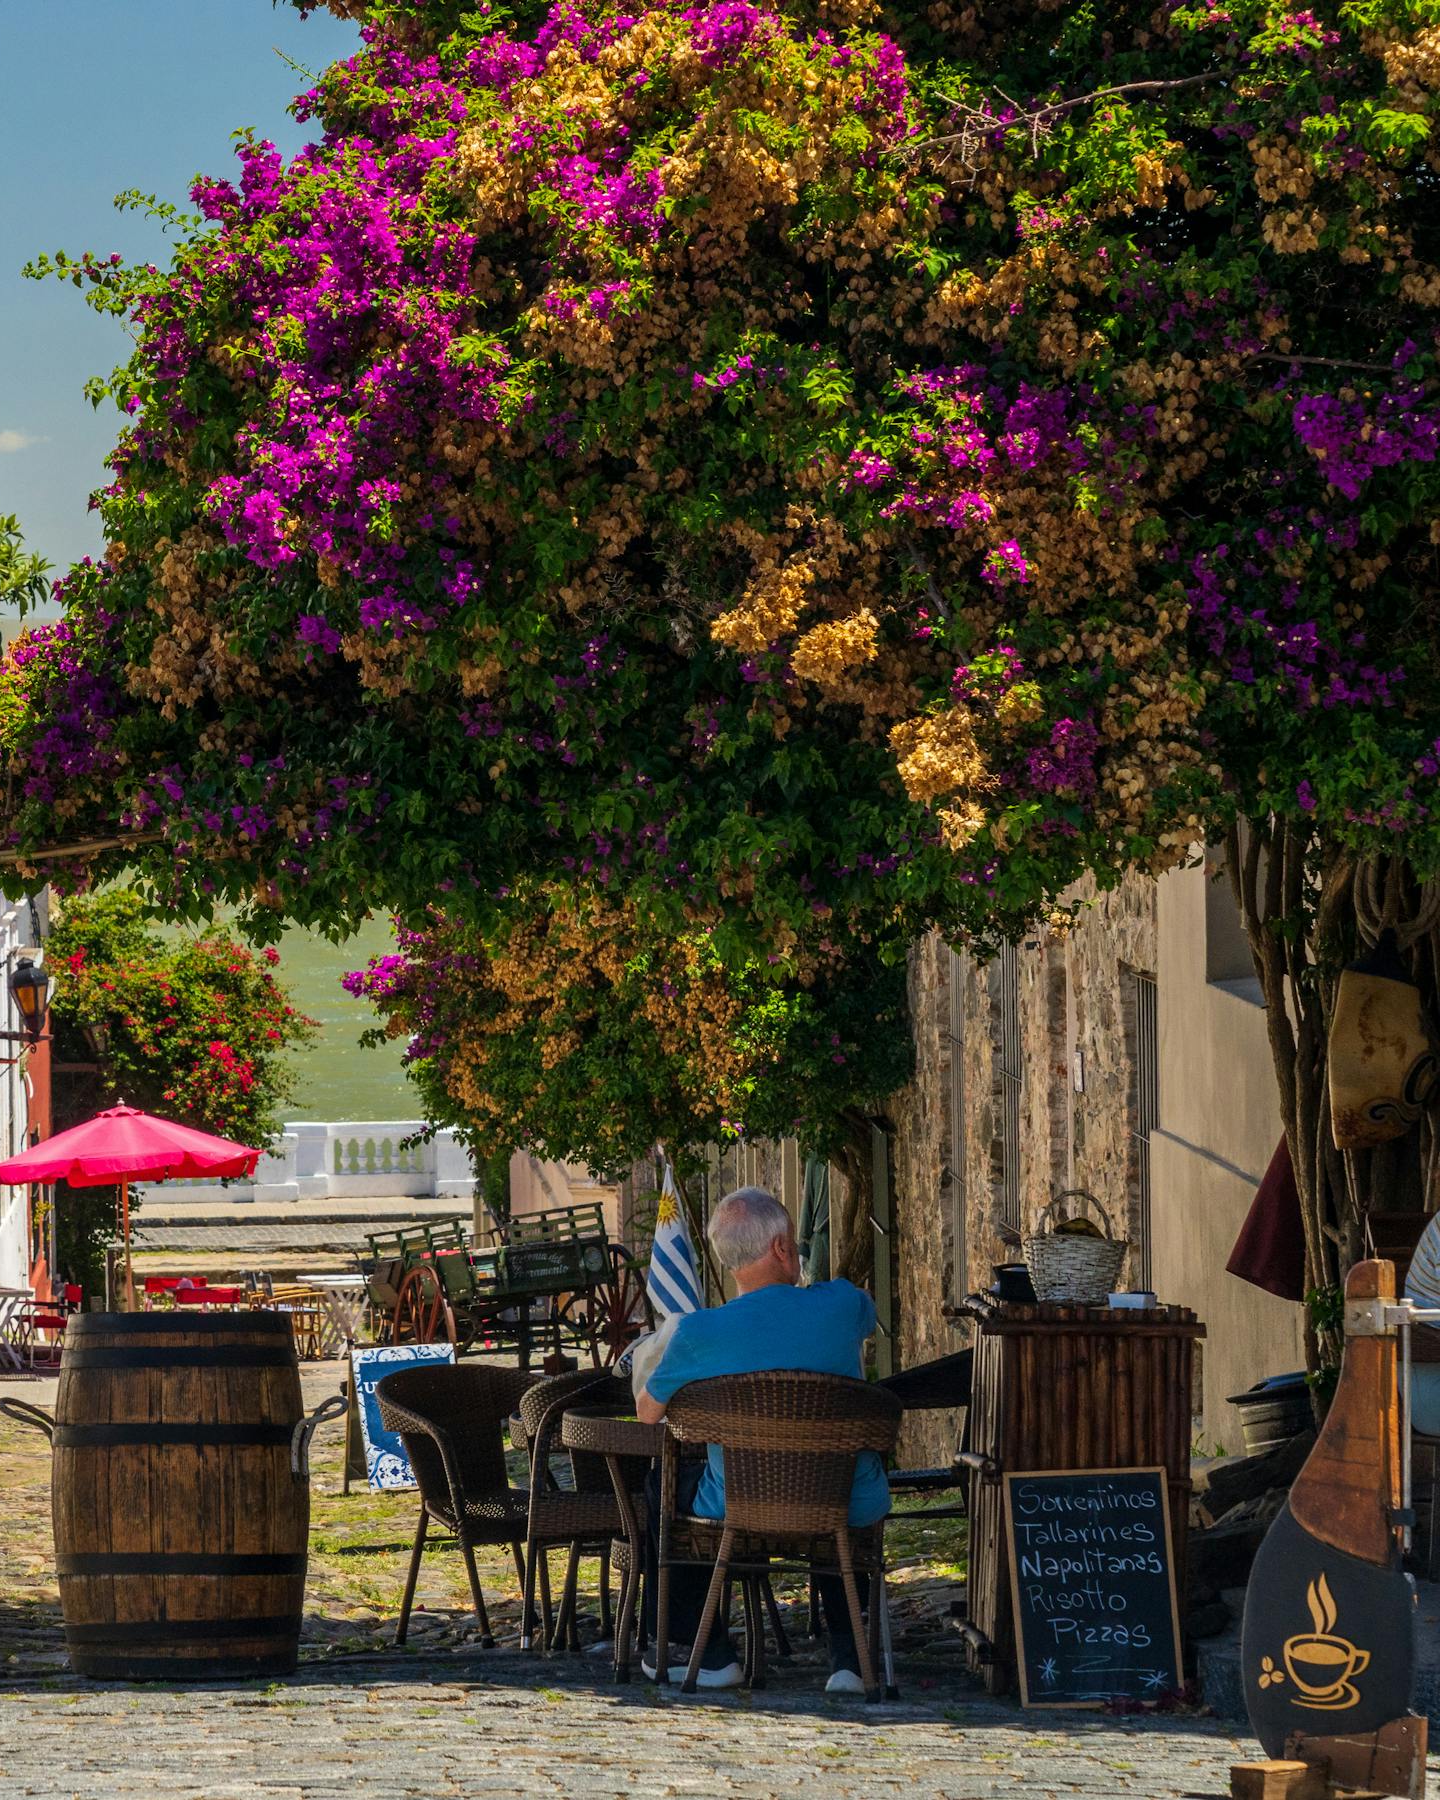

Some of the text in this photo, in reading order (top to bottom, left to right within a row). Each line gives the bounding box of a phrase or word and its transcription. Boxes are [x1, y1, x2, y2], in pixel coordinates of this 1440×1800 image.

[1019, 1484, 1157, 1514] Sorrentinos
[1014, 1520, 1156, 1545] Tallarines
[1021, 1548, 1163, 1584] Napolitanas
[1026, 1579, 1127, 1613] Risotto
[1047, 1617, 1152, 1648] Pizzas
